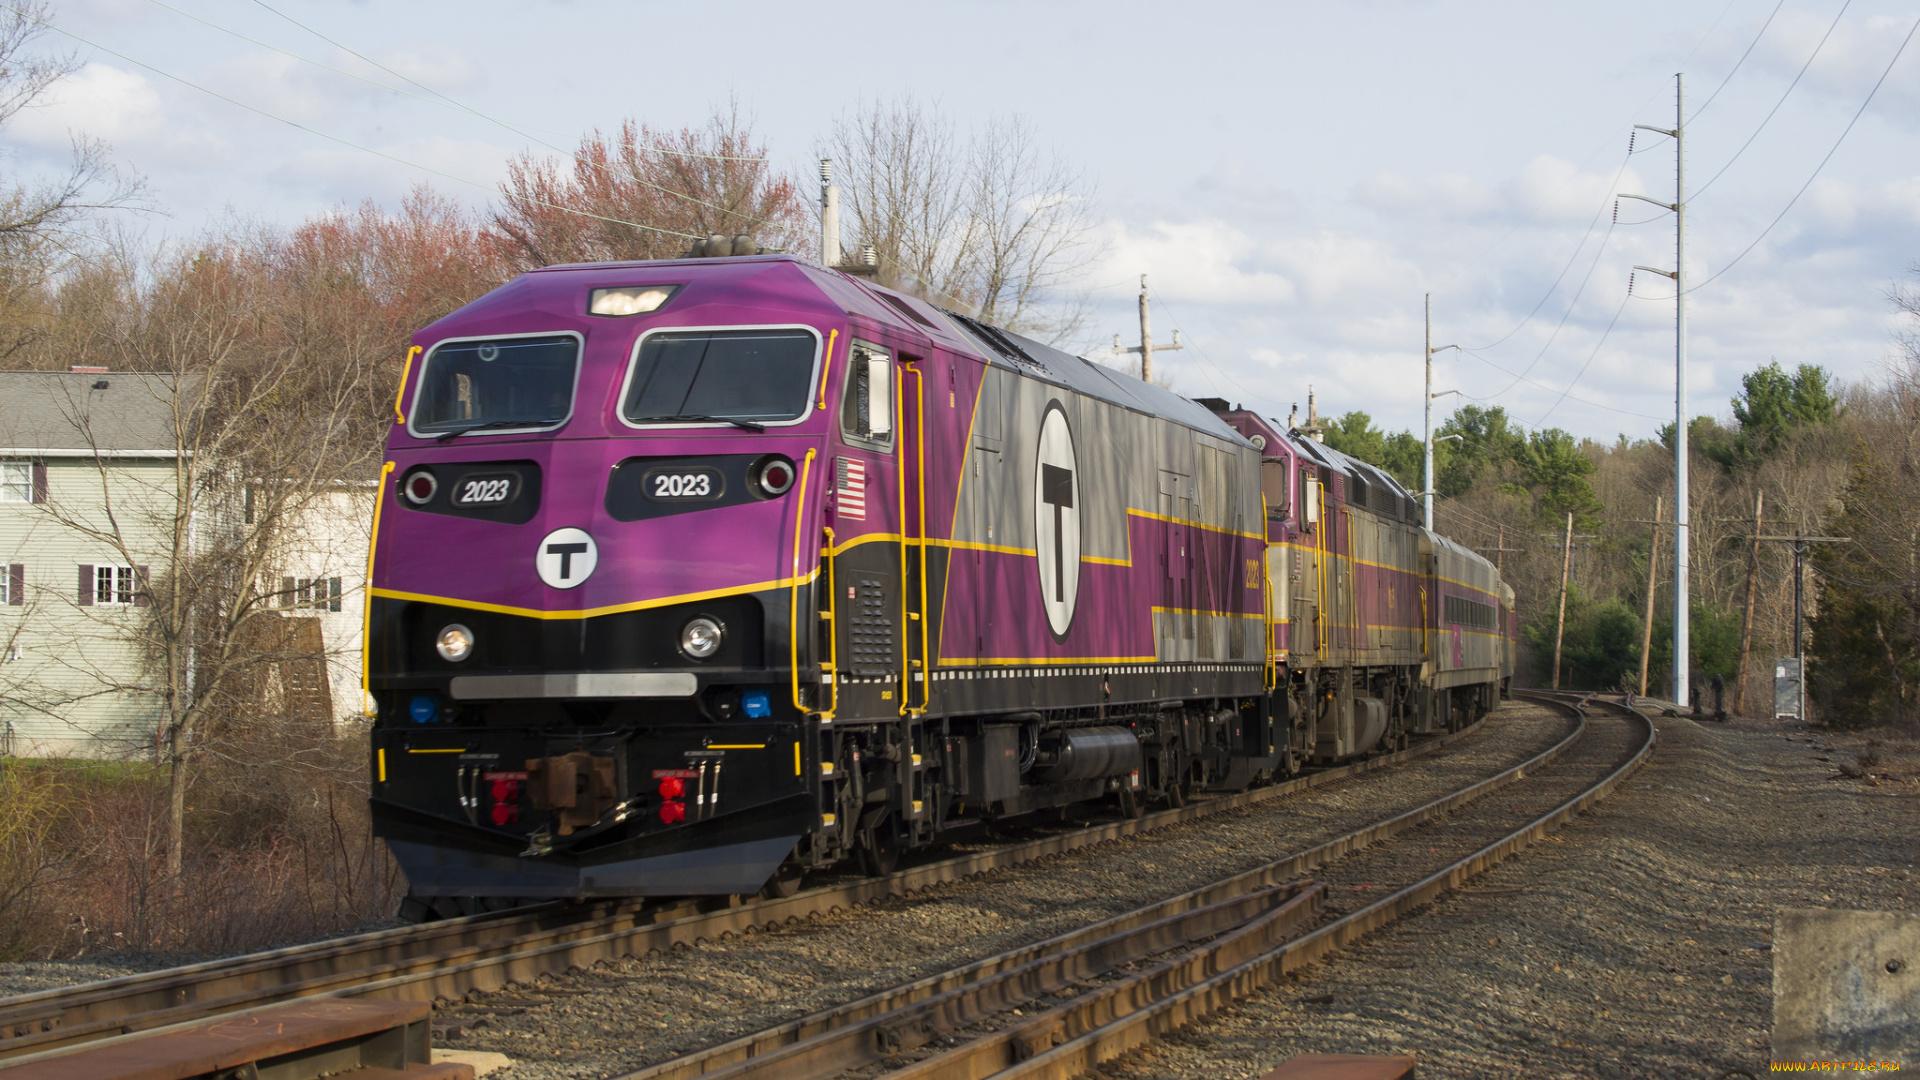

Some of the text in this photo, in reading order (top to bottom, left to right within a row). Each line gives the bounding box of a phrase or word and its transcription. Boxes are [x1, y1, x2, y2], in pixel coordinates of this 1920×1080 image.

[461, 479, 510, 503] 2023
[655, 474, 711, 497] 2023
[1042, 462, 1073, 603] T
[546, 542, 588, 579] T
[1246, 558, 1260, 590] 2023
